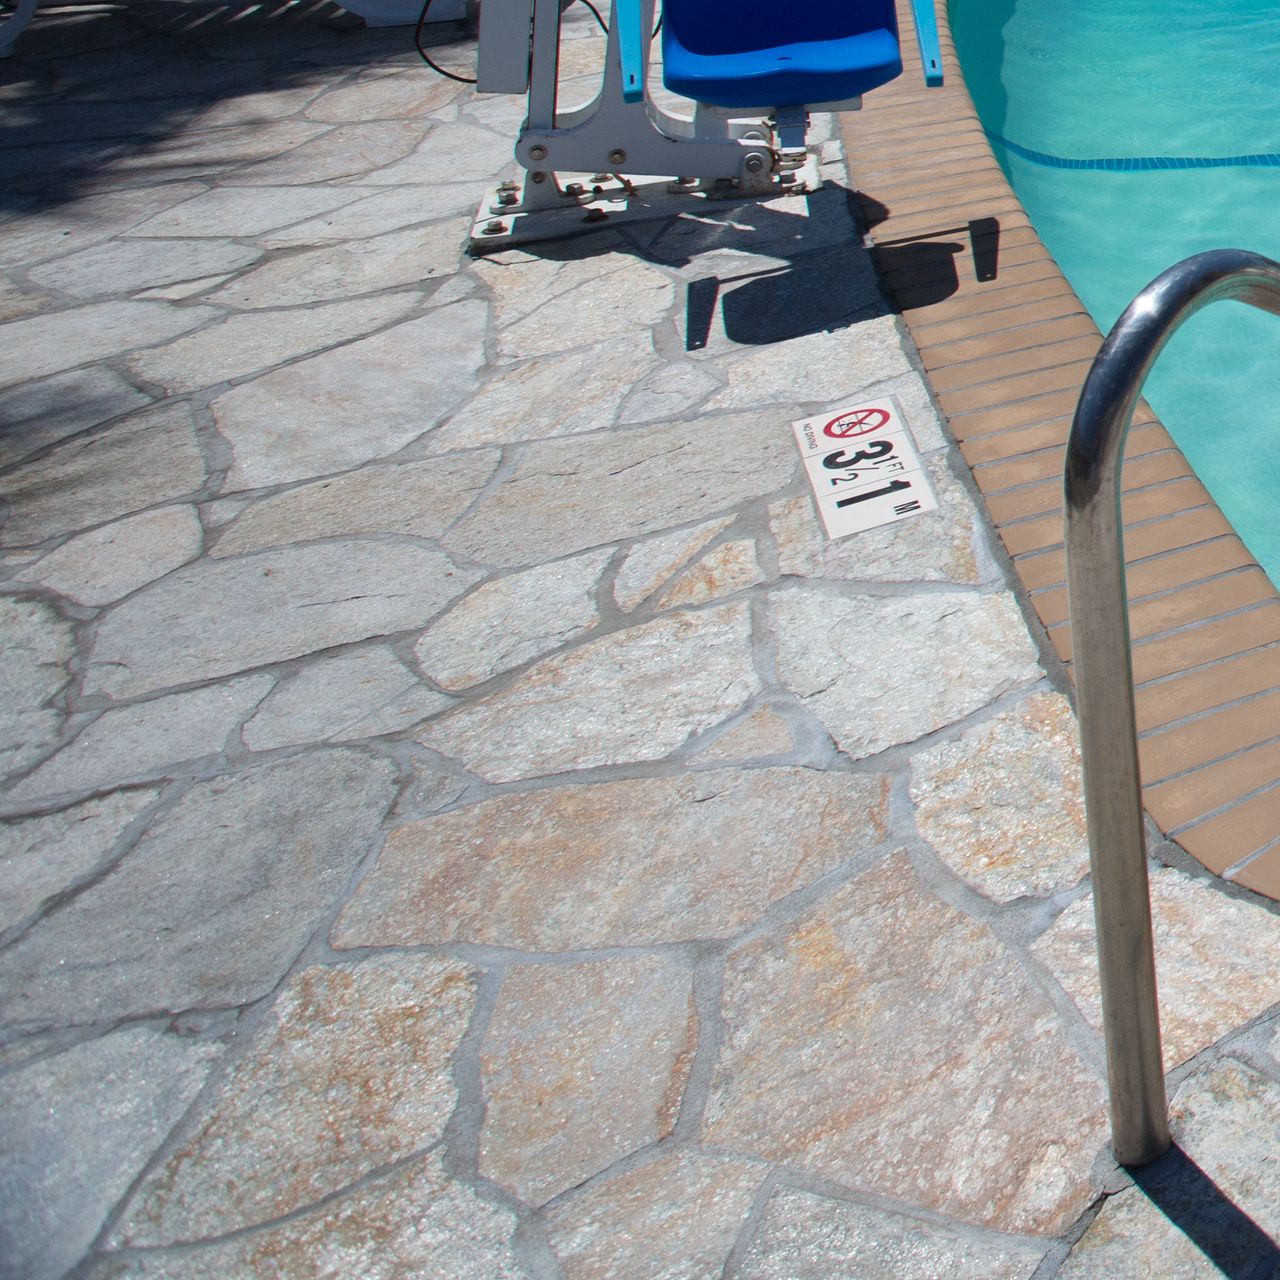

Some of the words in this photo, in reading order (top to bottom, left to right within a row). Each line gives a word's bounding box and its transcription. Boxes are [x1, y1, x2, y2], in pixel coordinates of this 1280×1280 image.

[802, 423, 812, 431] NO
[804, 431, 818, 449] DIVING
[886, 461, 904, 472] FT
[836, 480, 912, 508] 1
[893, 500, 921, 515] M
